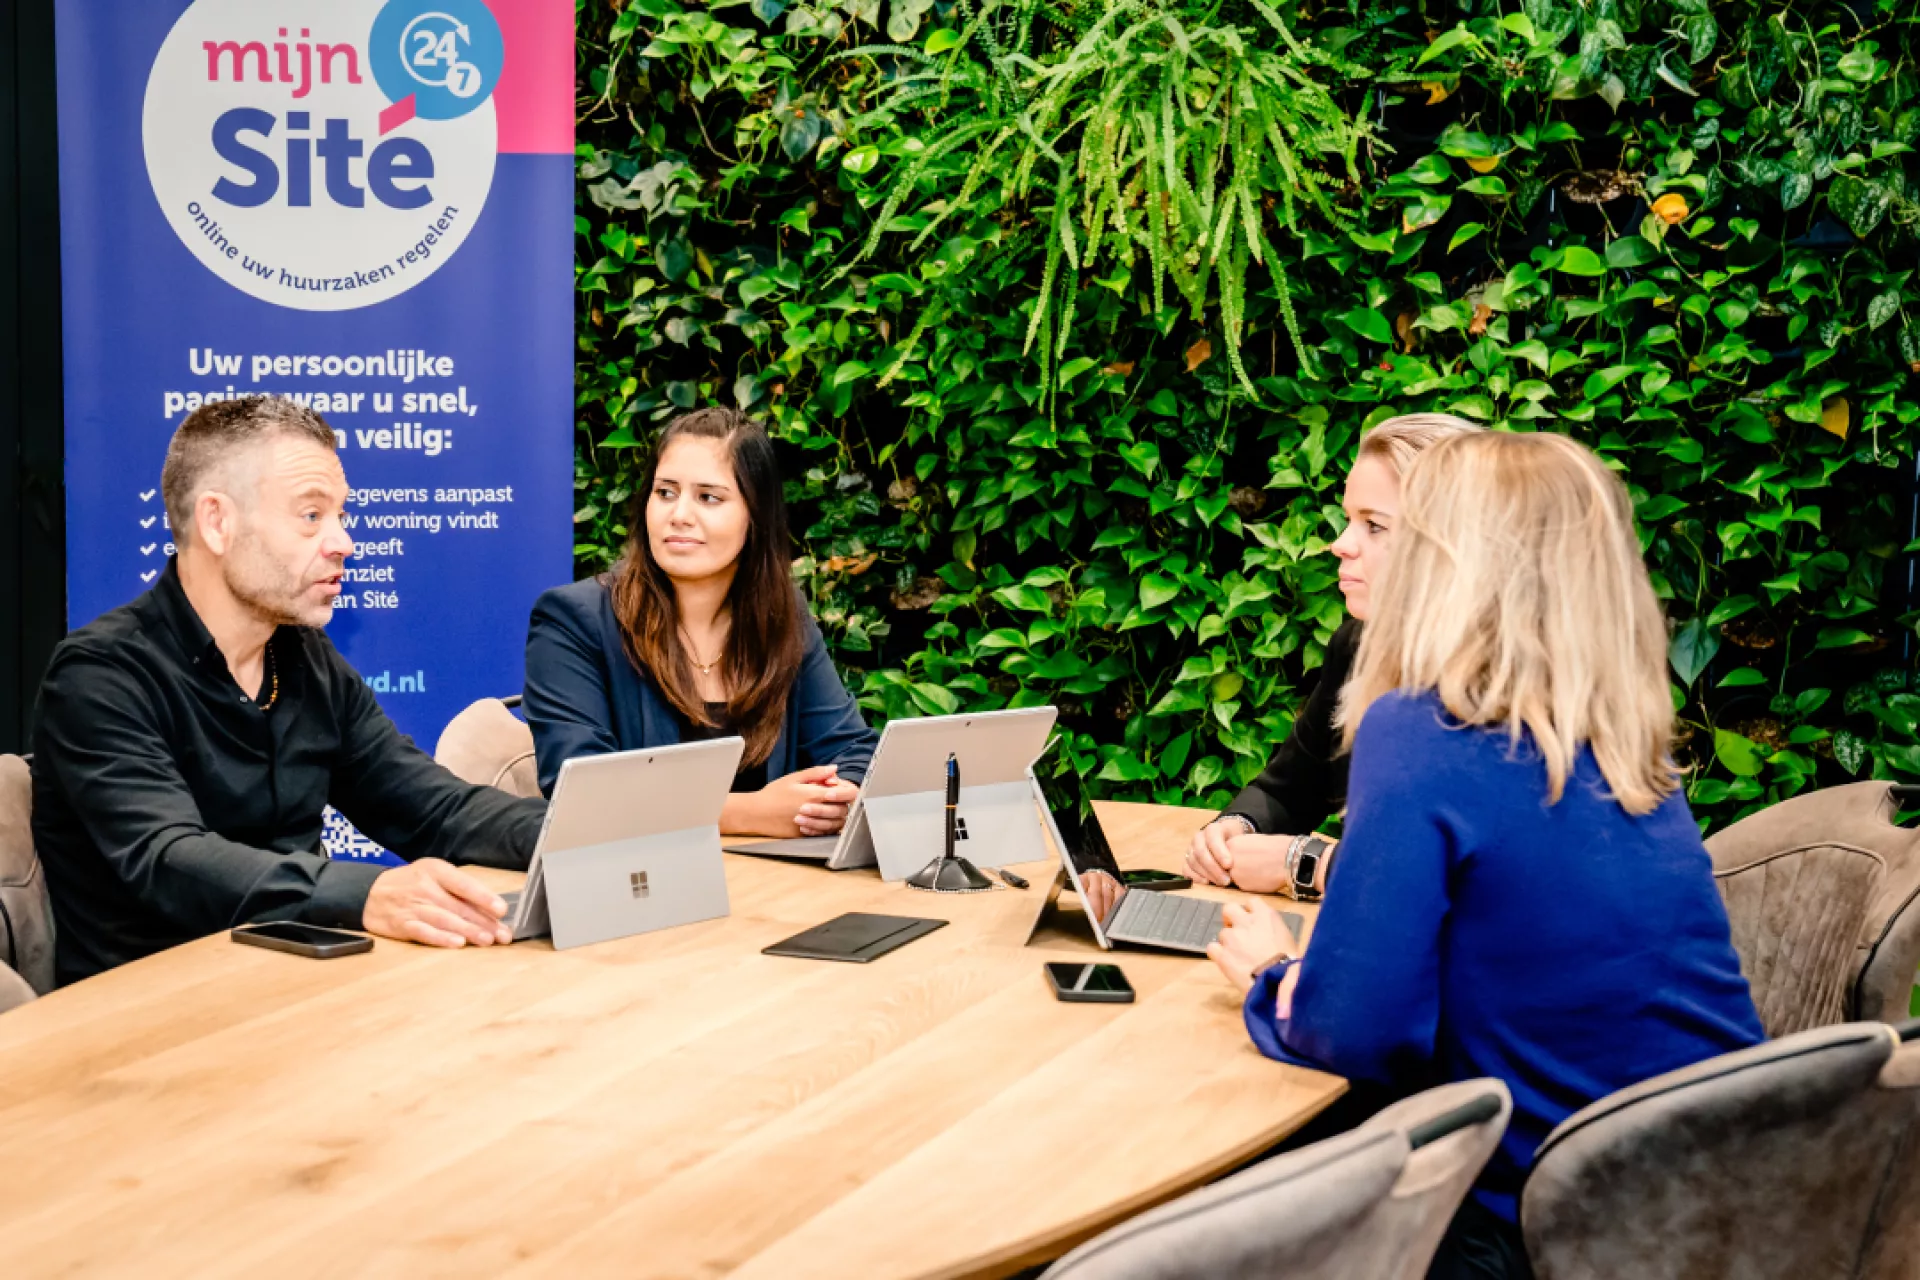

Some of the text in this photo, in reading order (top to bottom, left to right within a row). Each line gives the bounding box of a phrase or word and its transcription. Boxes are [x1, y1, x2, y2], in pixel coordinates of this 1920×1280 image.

[202, 27, 362, 98] mijn
[413, 30, 471, 91] 24 7
[211, 92, 435, 210] Sité
[187, 201, 459, 292] online uw huurzaken regelen
[189, 348, 454, 382] Uw persoonlijke
[374, 393, 393, 413] u
[402, 387, 478, 416] snel,
[356, 423, 453, 456] veilig:
[434, 485, 513, 506] aanpast
[364, 511, 441, 533] woning
[447, 511, 499, 529] vindt
[363, 590, 399, 609] Sité
